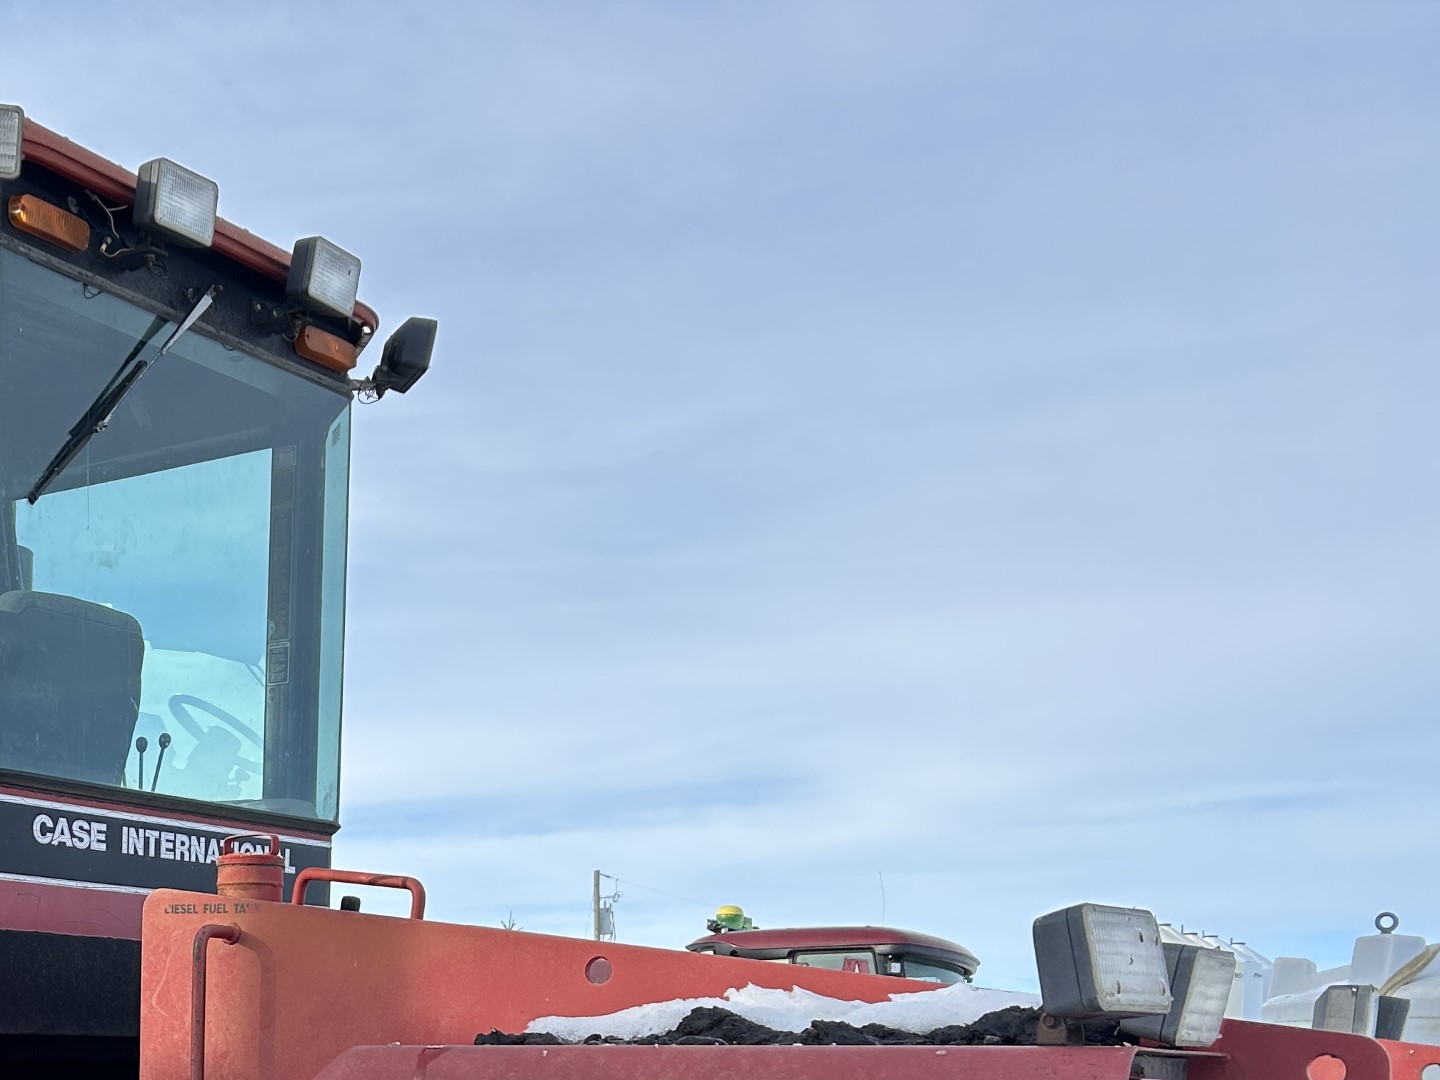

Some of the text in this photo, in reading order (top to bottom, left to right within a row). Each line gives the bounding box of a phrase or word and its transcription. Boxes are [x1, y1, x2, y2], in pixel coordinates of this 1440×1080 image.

[32, 813, 296, 875] CASE INTERNAL
[203, 903, 229, 914] FUEL
